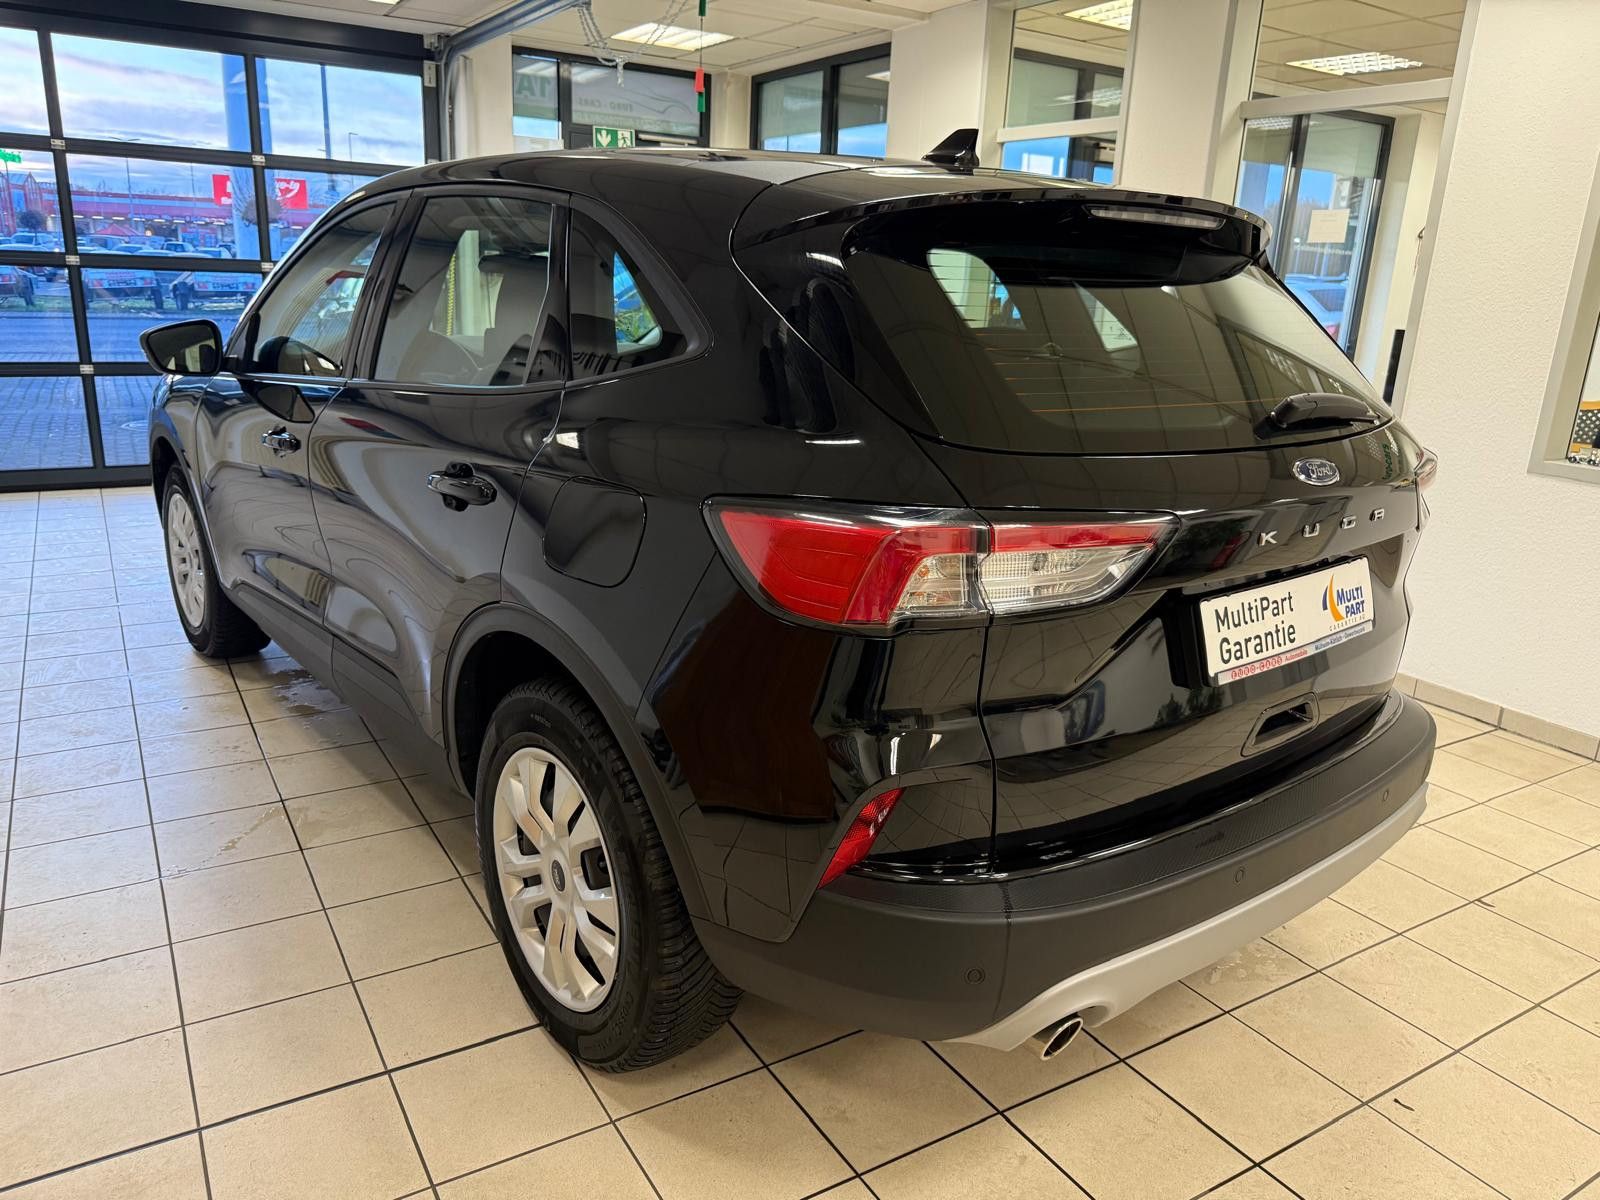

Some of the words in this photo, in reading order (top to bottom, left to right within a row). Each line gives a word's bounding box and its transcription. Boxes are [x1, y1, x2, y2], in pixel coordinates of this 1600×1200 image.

[1306, 459, 1334, 479] Ford
[1258, 508, 1385, 546] KUGA
[1214, 591, 1294, 633] MultiPart
[1344, 600, 1365, 618] PART
[1219, 620, 1296, 665] Garantie
